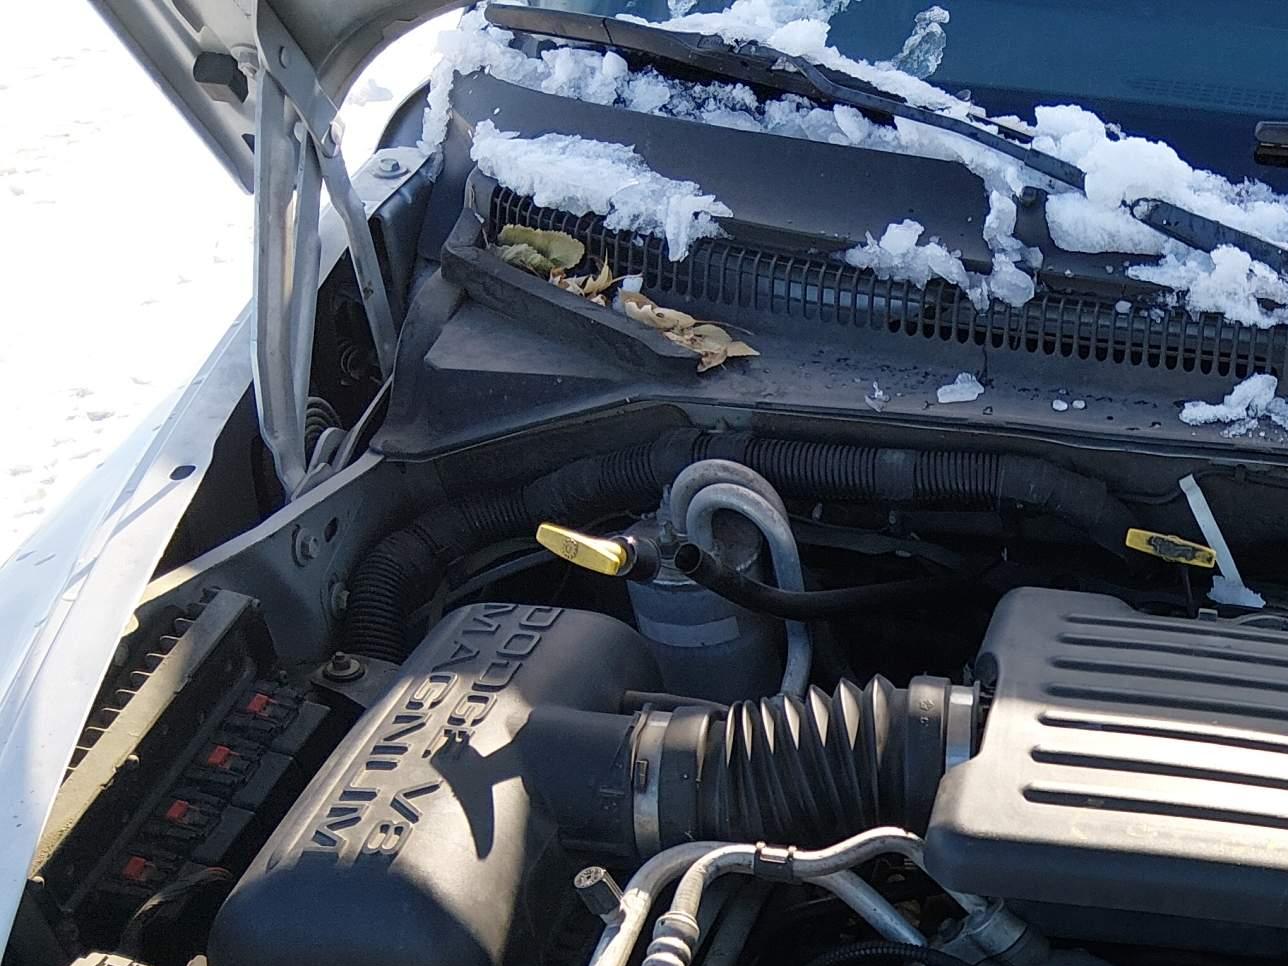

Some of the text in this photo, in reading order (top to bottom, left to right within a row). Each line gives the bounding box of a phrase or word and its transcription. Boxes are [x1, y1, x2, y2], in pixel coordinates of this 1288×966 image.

[312, 603, 519, 852] MAGNUM
[364, 606, 565, 855] DODGE V8
